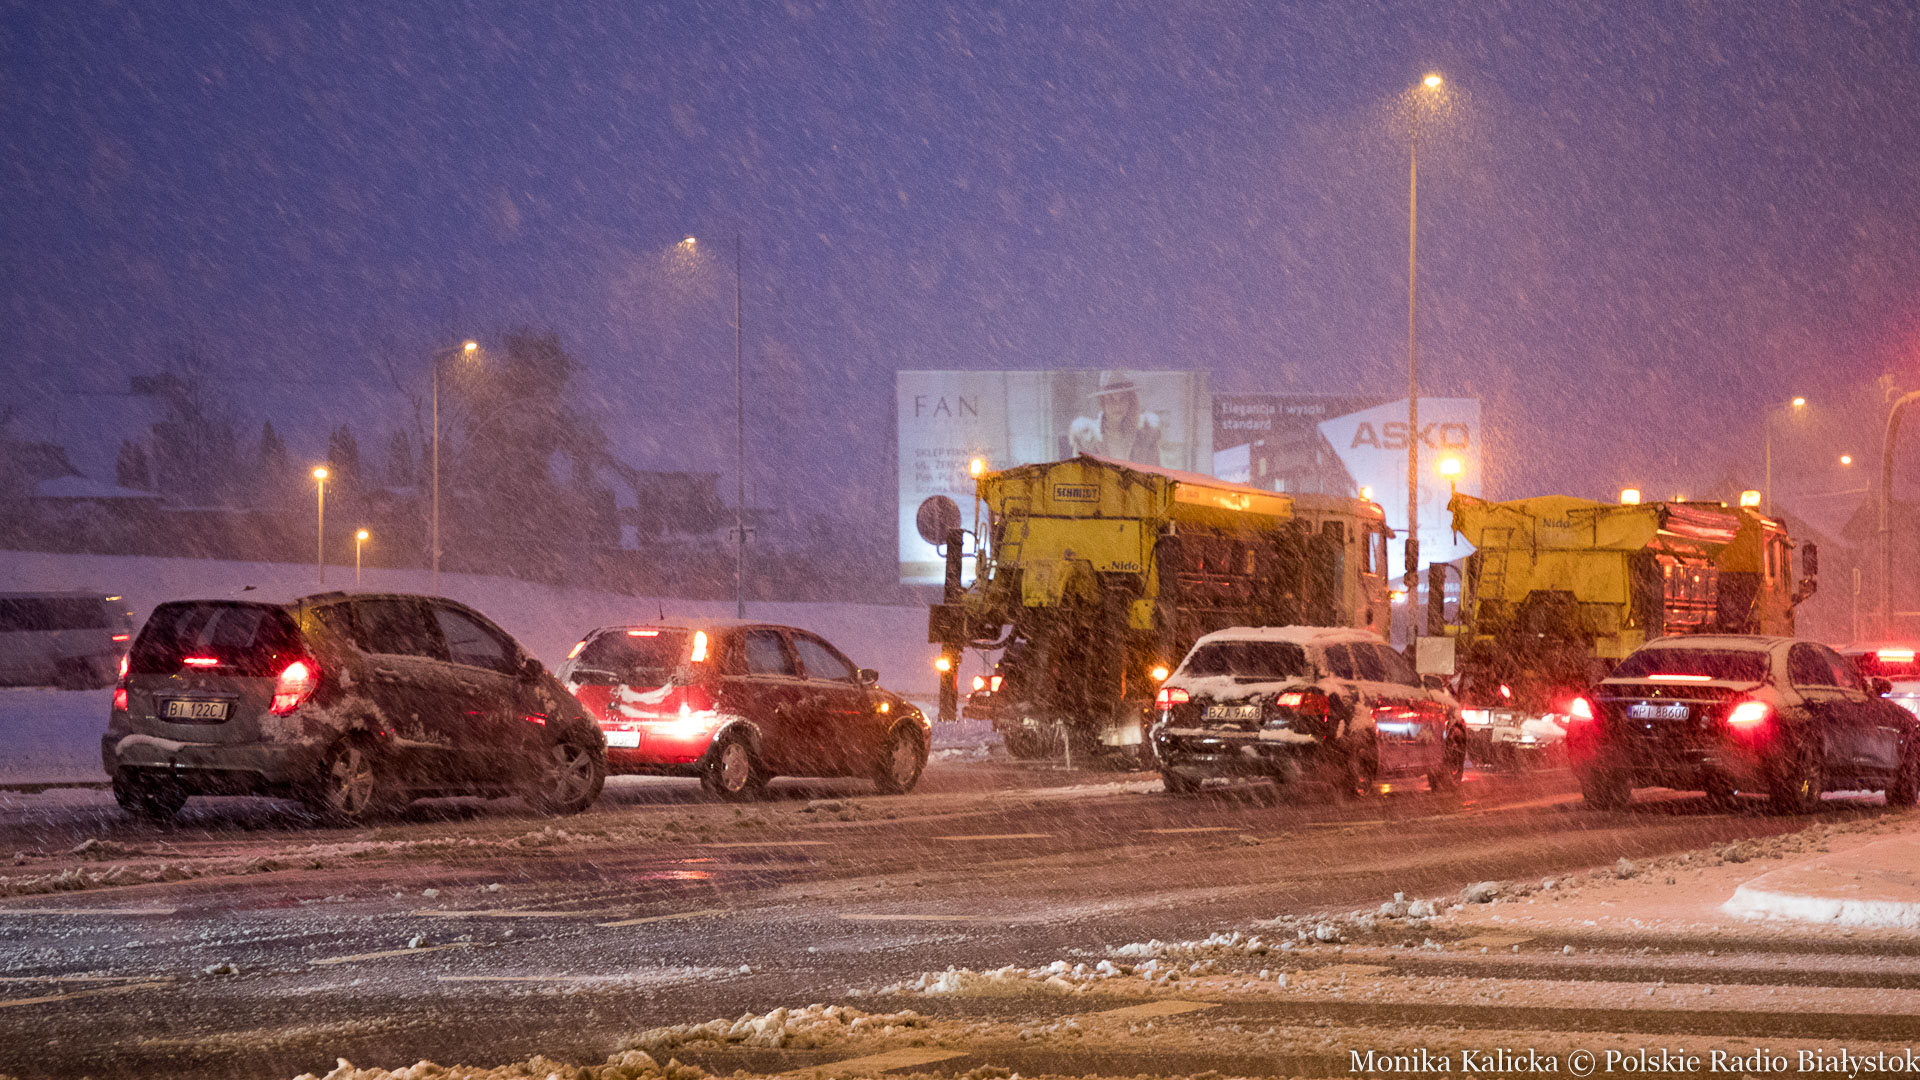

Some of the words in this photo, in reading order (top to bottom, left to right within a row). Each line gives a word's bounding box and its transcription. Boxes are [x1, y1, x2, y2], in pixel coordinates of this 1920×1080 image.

[914, 395, 978, 418] FAN
[1222, 402, 1275, 416] Elegancja
[1286, 402, 1326, 416] wysoki
[1222, 418, 1272, 431] standard
[1351, 421, 1470, 449] ASKO
[1056, 487, 1097, 498] SCHMIDT
[1543, 516, 1570, 529] Nido
[1111, 560, 1139, 571] Nido
[169, 702, 184, 716] BI
[191, 703, 226, 718] 122CJ
[1209, 707, 1231, 719] BZA
[1655, 707, 1689, 719] 88600
